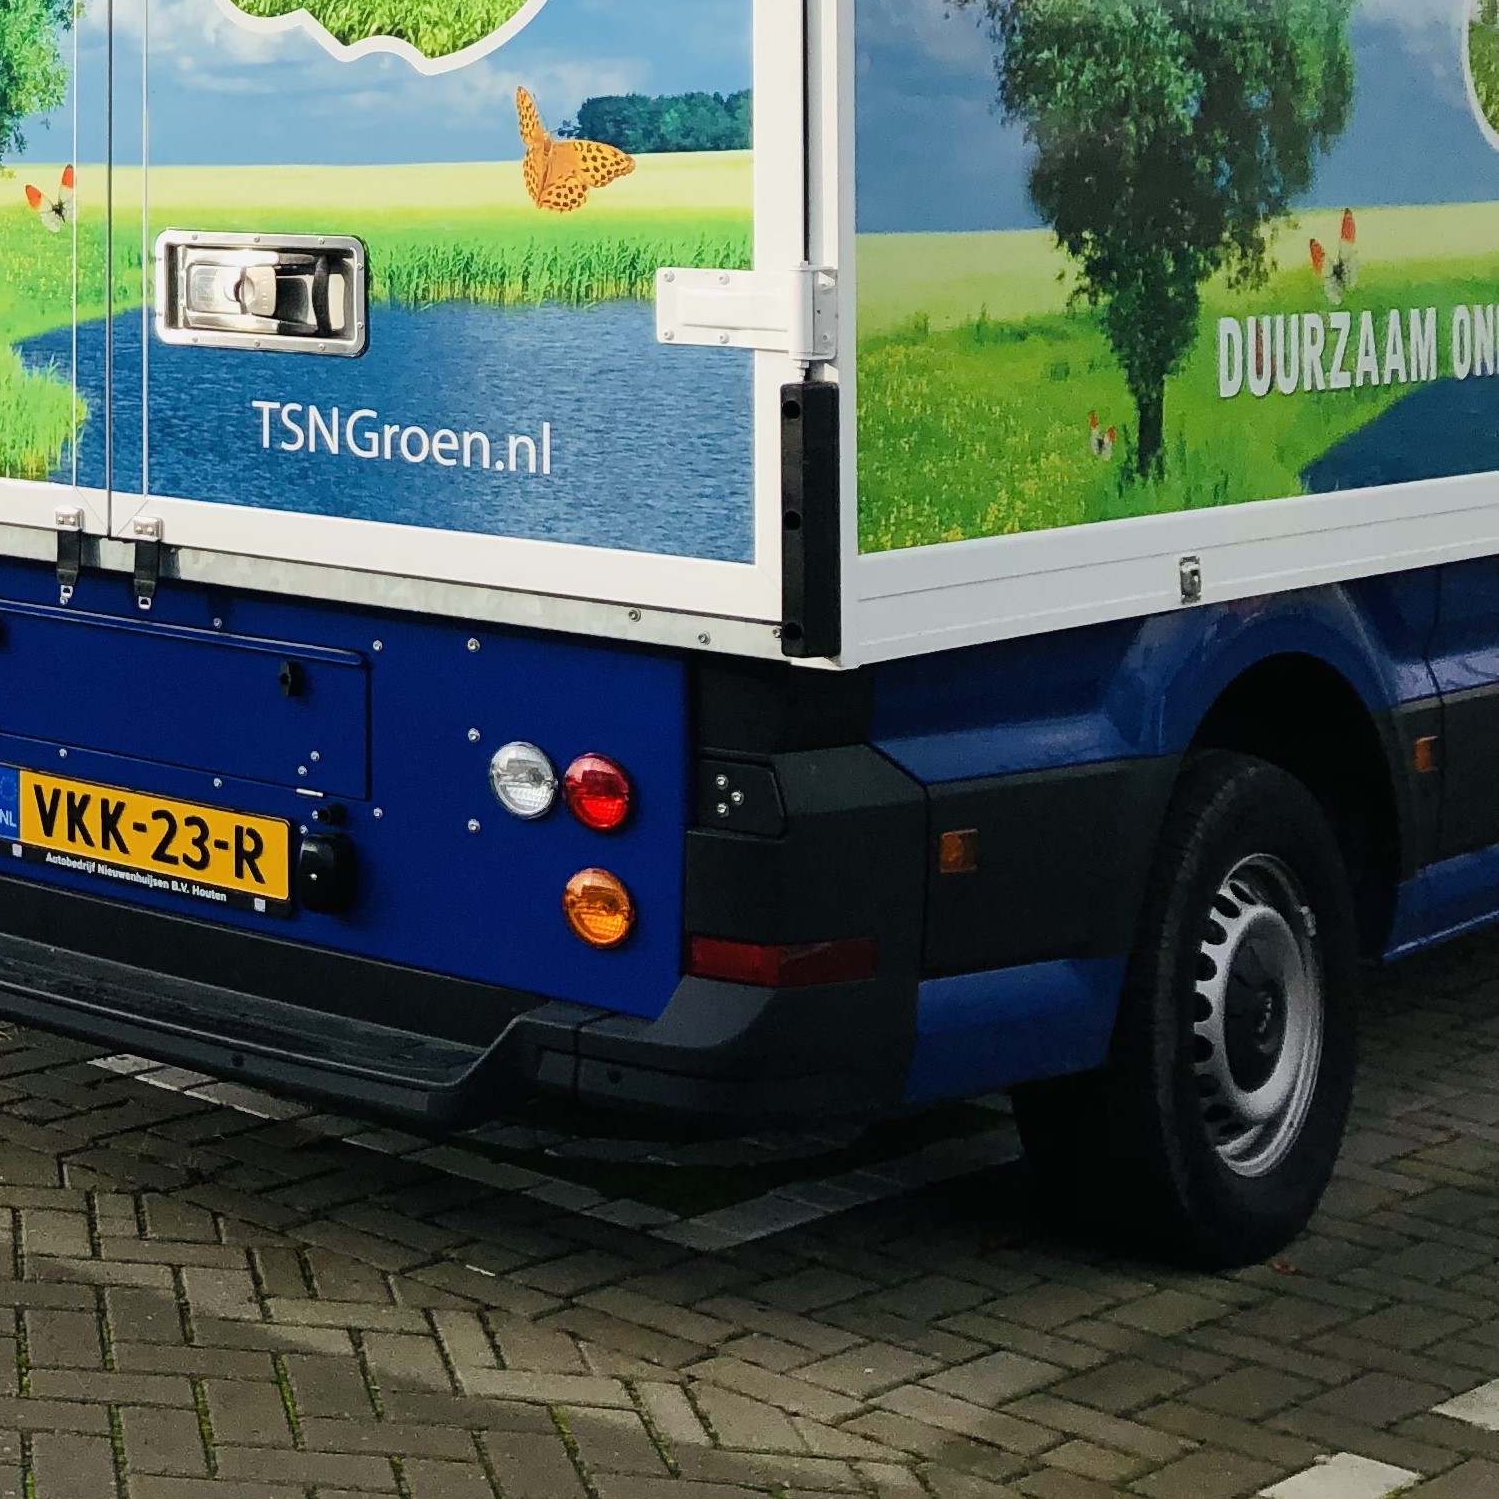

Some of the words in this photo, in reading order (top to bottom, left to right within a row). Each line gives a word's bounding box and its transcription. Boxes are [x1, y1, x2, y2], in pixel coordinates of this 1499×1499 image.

[1218, 306, 1438, 399] DUURZAAM
[1452, 303, 1499, 381] ON
[252, 401, 553, 476] TSNGroen.nl
[33, 783, 266, 885] VKK-23-R
[45, 852, 96, 875] Autobedrijf
[97, 863, 170, 890] Nieuwenhuijsen
[171, 879, 190, 895] B.V.
[191, 885, 227, 903] Houten
